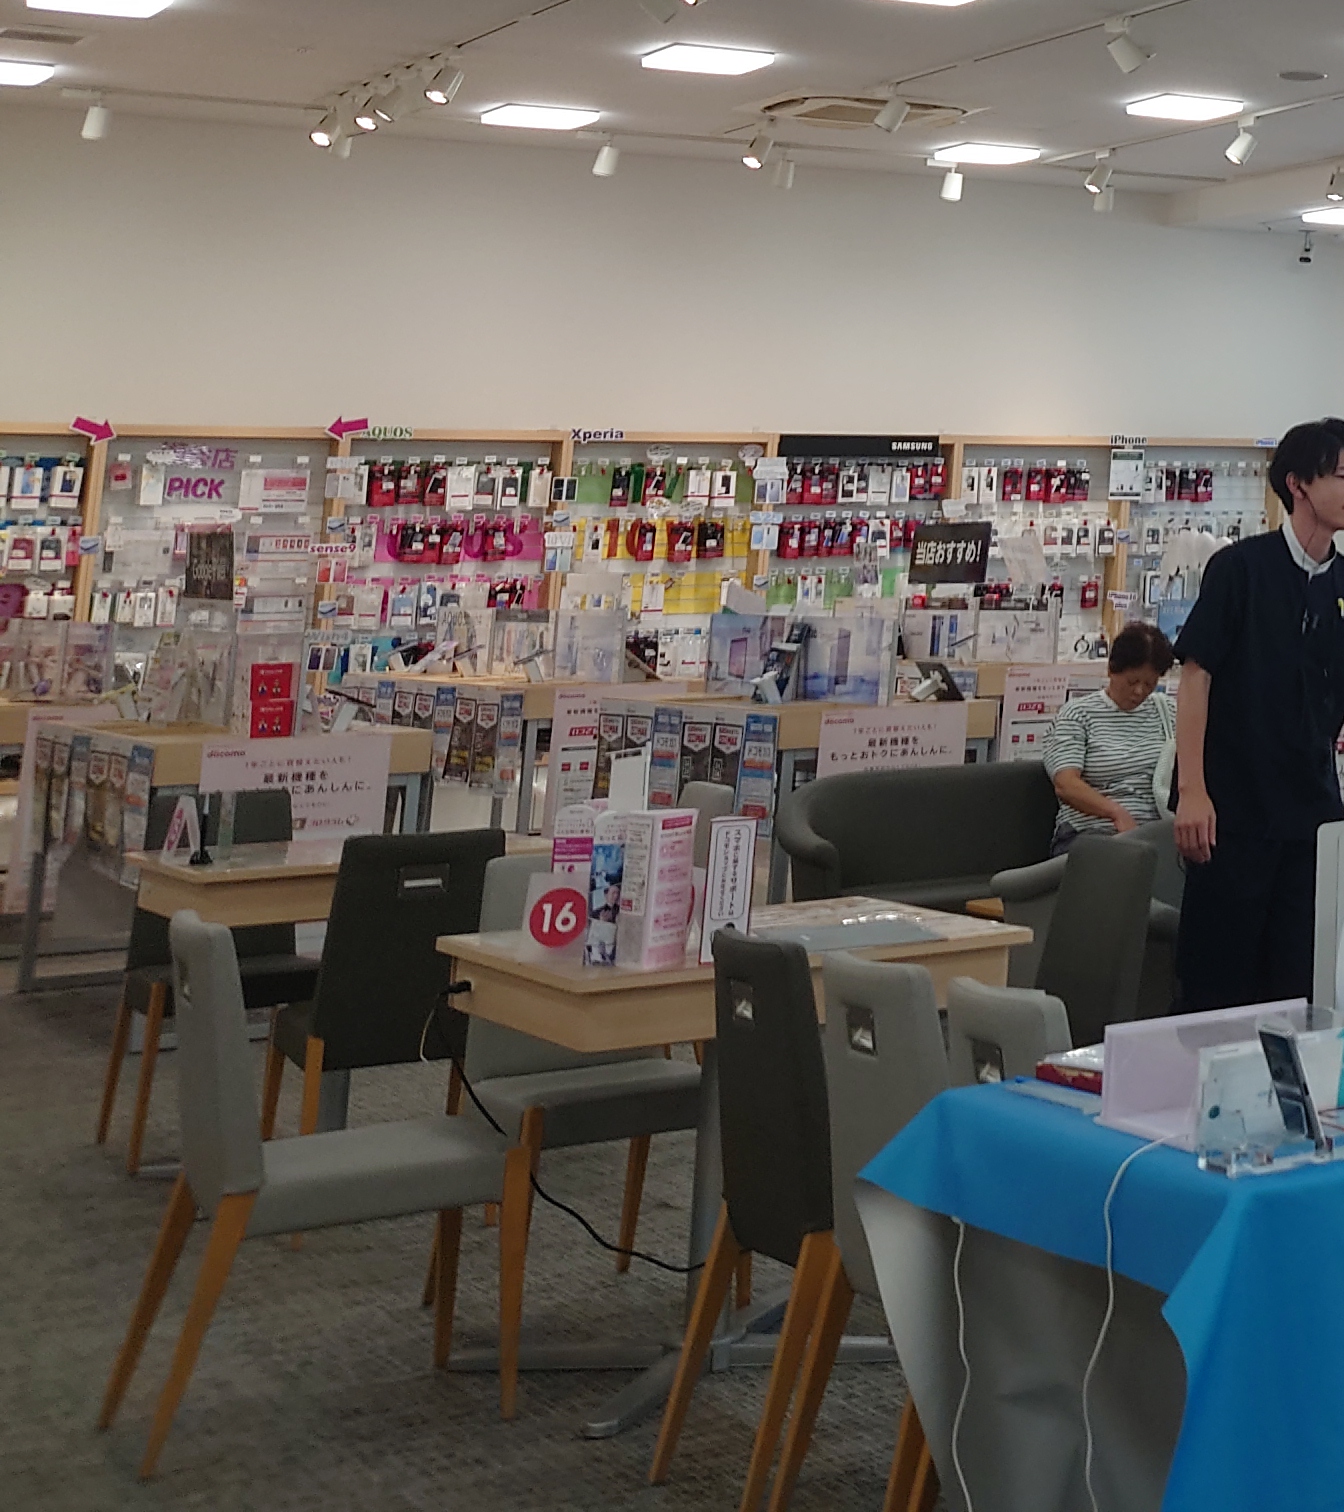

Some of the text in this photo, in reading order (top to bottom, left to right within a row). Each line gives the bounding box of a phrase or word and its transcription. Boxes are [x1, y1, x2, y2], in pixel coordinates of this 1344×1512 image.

[571, 428, 624, 442] Xperia
[891, 441, 933, 451] SAMSUNG
[165, 476, 225, 499] PICK
[308, 543, 356, 554] sense9
[915, 539, 982, 565] 当店おすすめ!
[541, 902, 577, 934] 16
